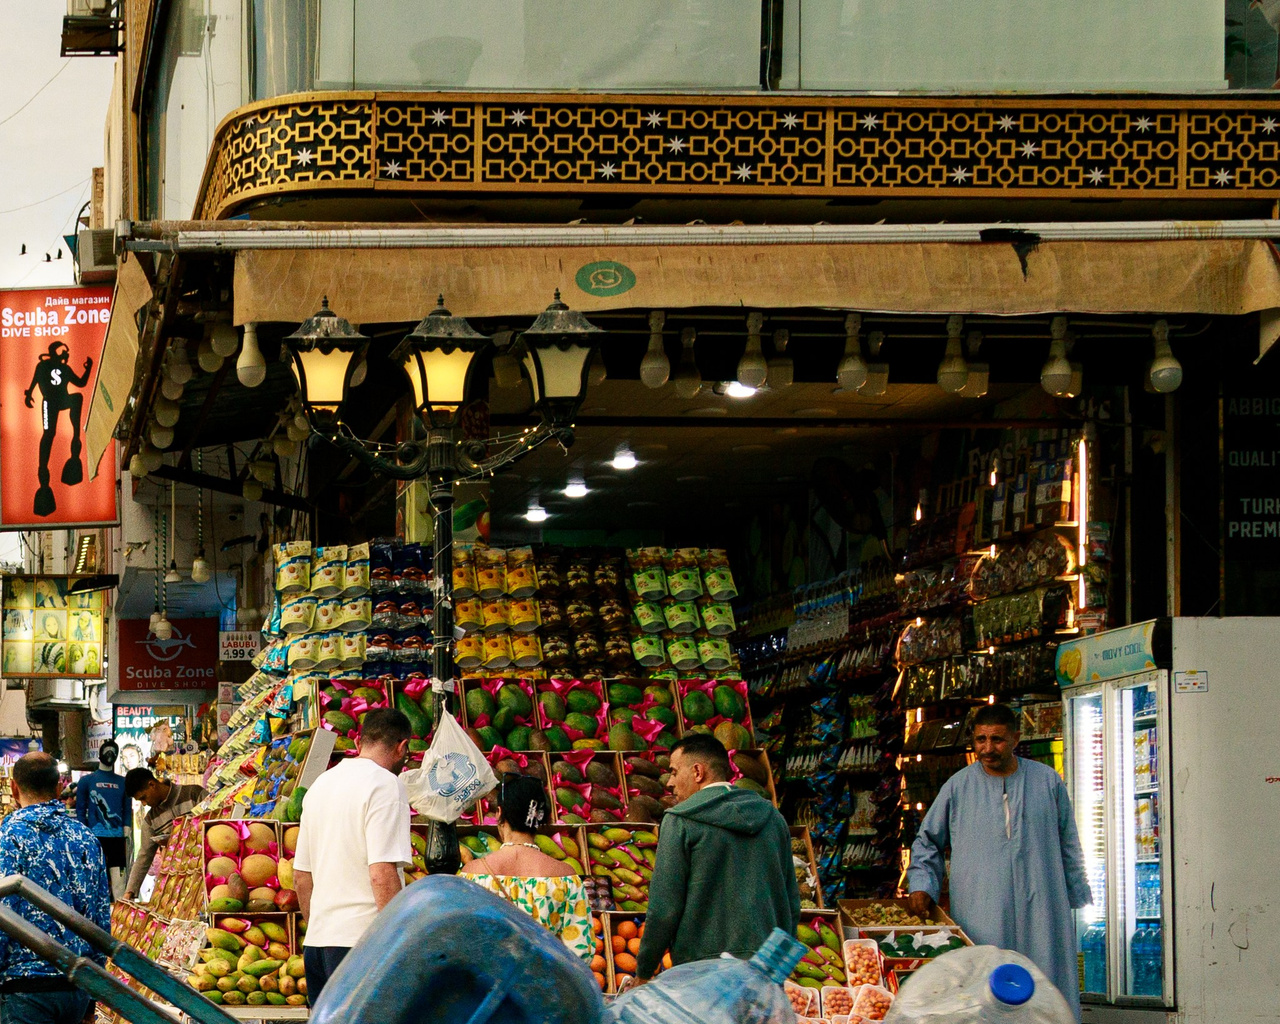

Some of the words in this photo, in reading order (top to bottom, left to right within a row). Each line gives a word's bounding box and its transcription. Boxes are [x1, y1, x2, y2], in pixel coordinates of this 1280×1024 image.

[45, 296, 69, 307] Дайв
[72, 296, 110, 305] магазин
[1, 306, 59, 327] Scuba
[64, 305, 110, 325] Zone
[1, 327, 31, 337] DIVE
[34, 325, 69, 337] SHOP
[1229, 450, 1280, 467] QUALI
[222, 641, 257, 649] LABUBU
[223, 649, 245, 659] 4.99
[247, 649, 255, 659] €
[126, 666, 172, 680] Scuba
[175, 665, 215, 678] Zone
[136, 681, 166, 689] DIVE
[174, 680, 207, 688] SHOP
[116, 706, 152, 716] BEAUTY
